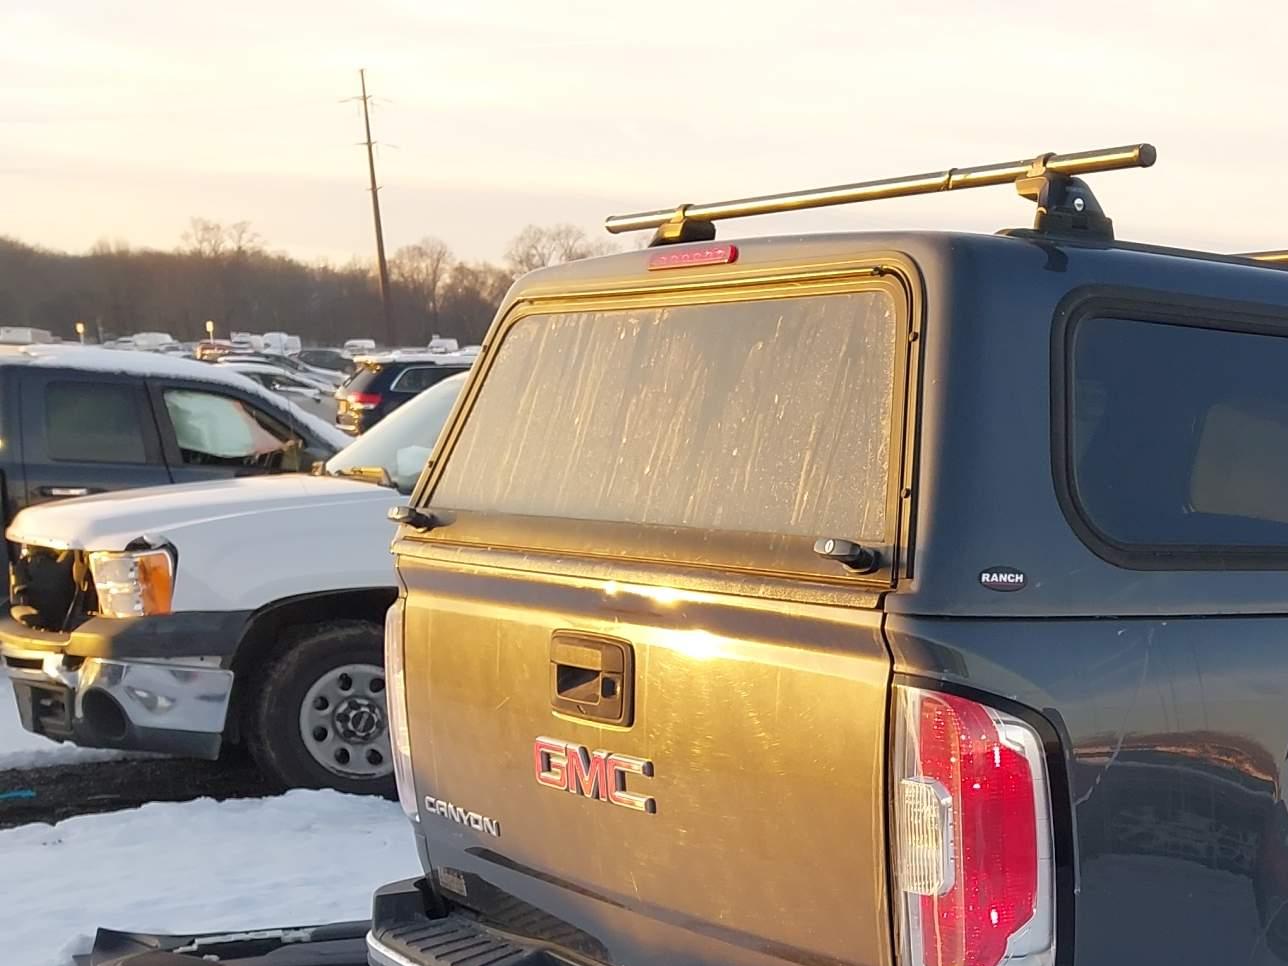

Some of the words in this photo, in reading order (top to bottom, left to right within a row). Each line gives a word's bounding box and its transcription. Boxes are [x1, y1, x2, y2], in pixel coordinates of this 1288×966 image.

[981, 572, 1024, 583] RANCH
[534, 735, 656, 814] GMC
[424, 795, 500, 837] CANYON
